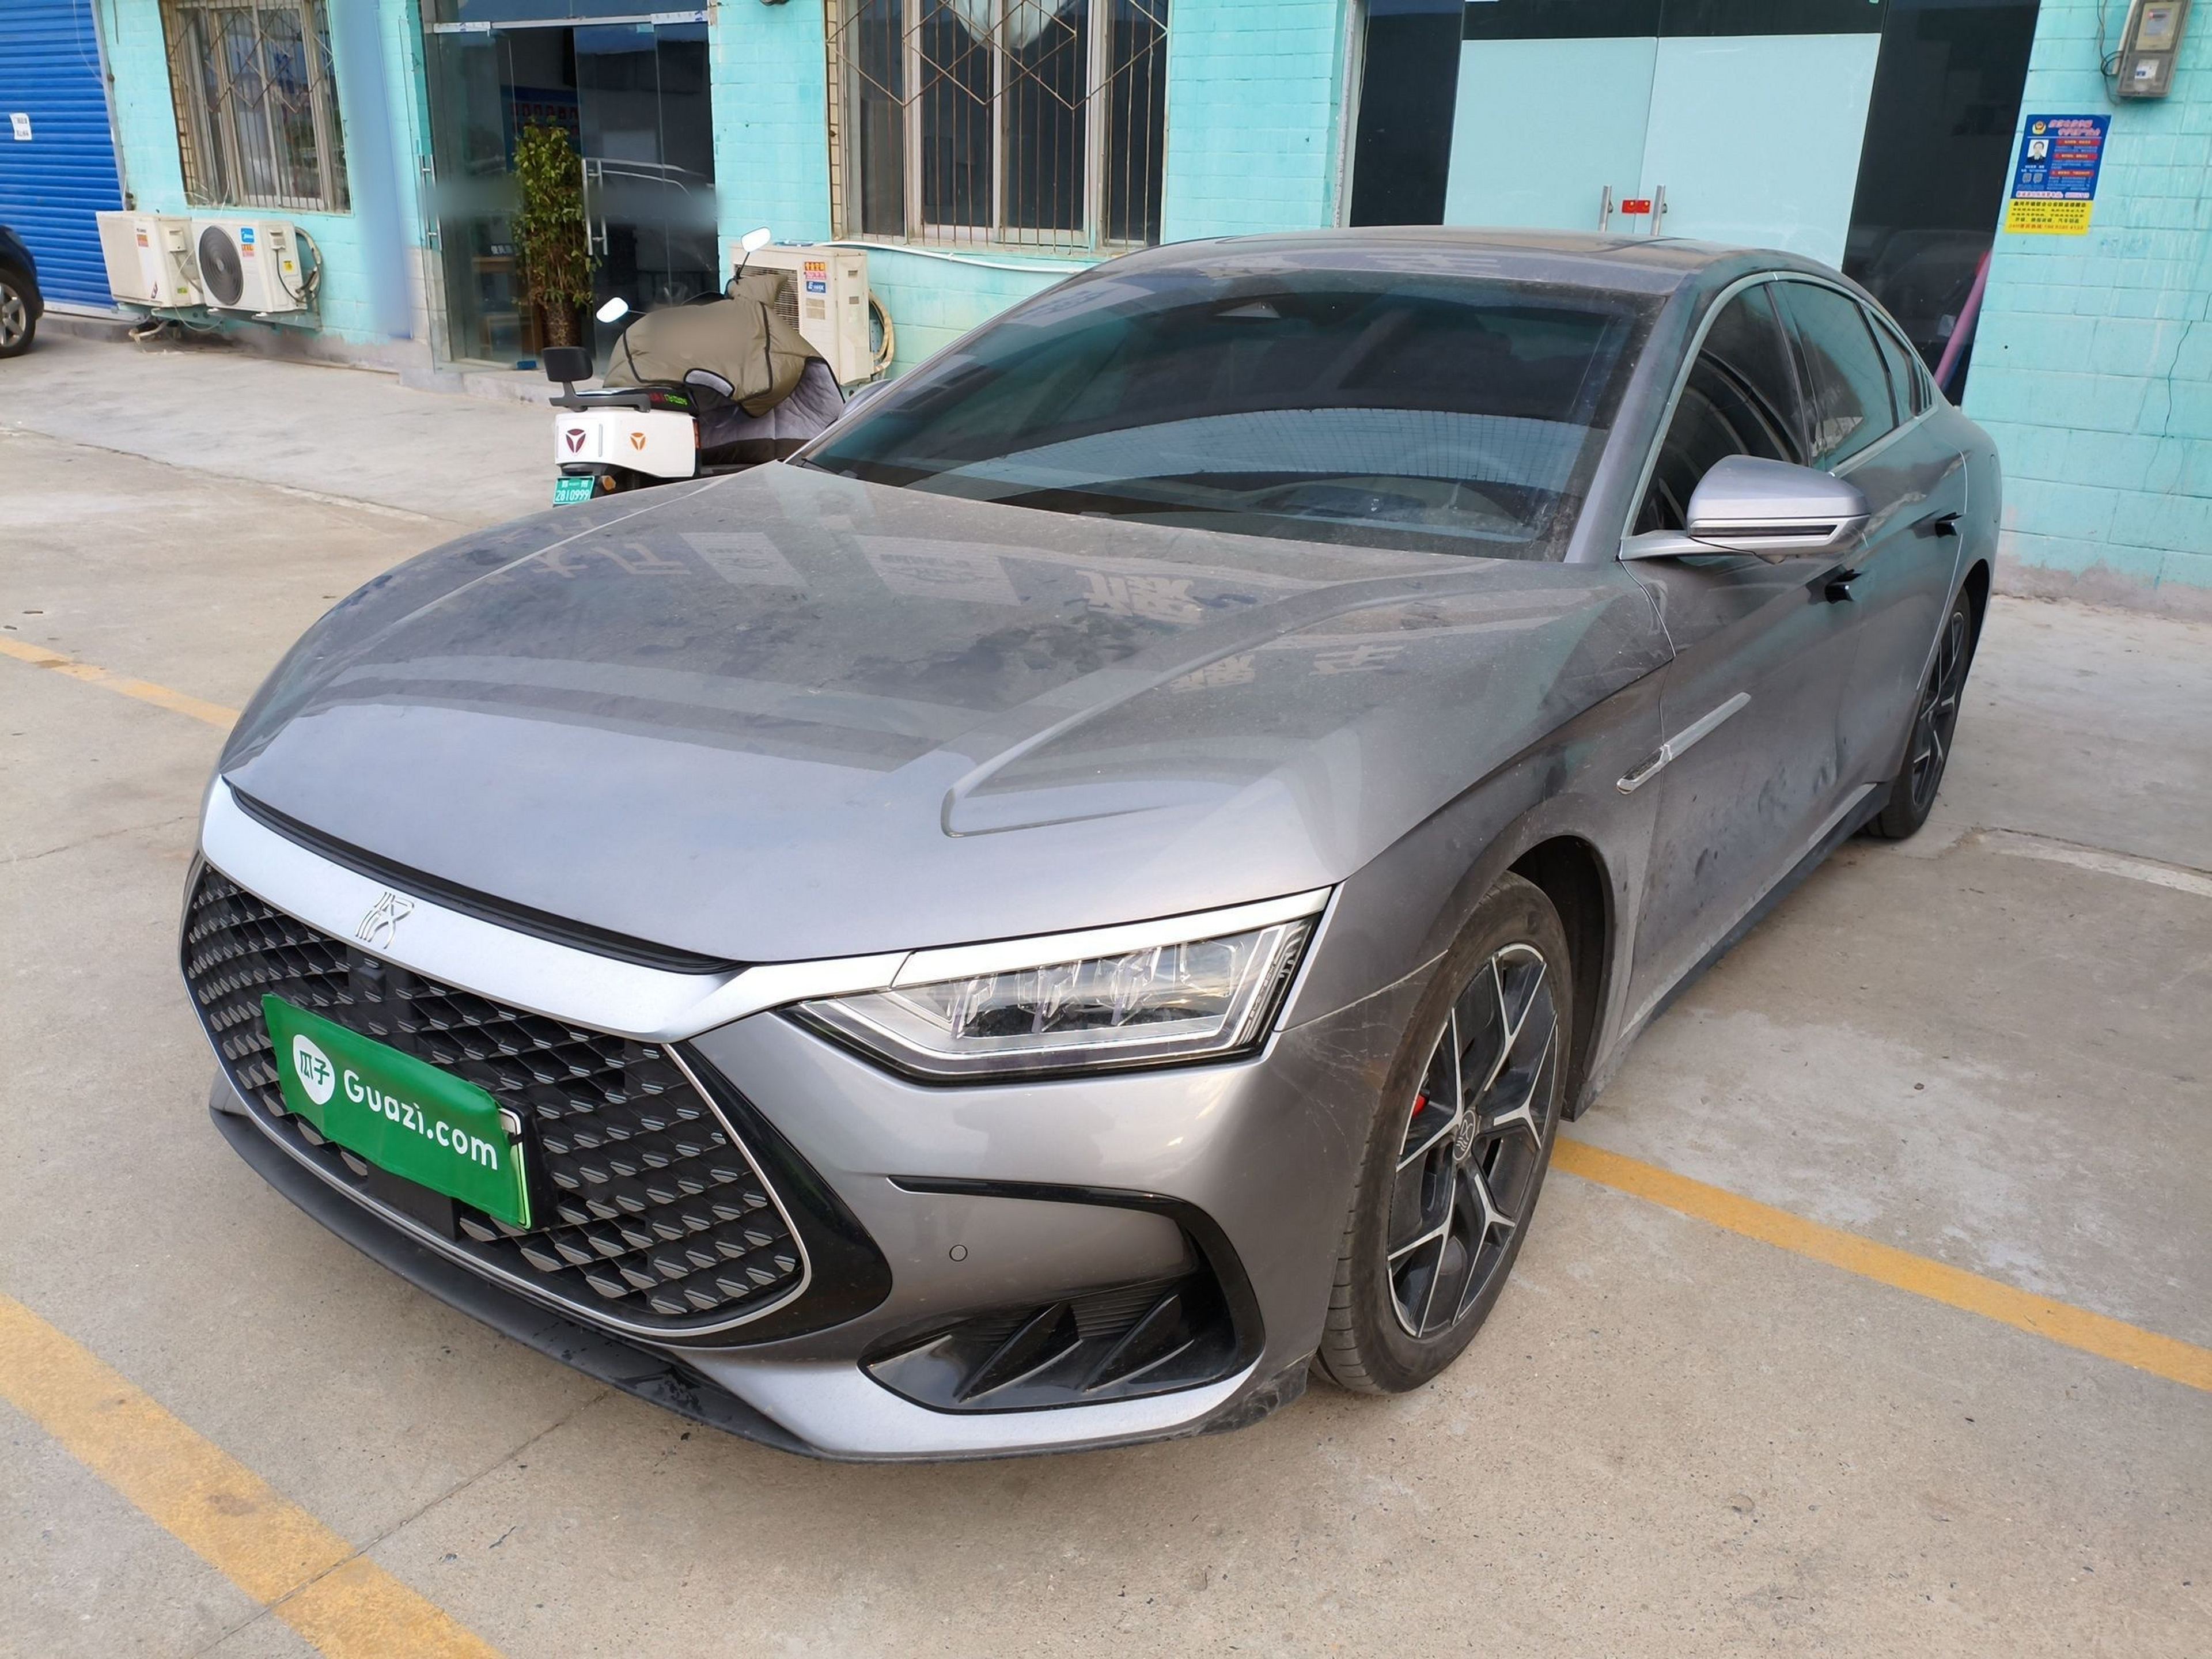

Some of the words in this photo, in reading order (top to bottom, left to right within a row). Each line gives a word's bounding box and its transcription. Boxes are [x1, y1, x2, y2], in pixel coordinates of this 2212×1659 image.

[555, 489, 590, 502] 2810999
[299, 1050, 330, 1086] 瓜子
[343, 1069, 498, 1171] Guazi.com
